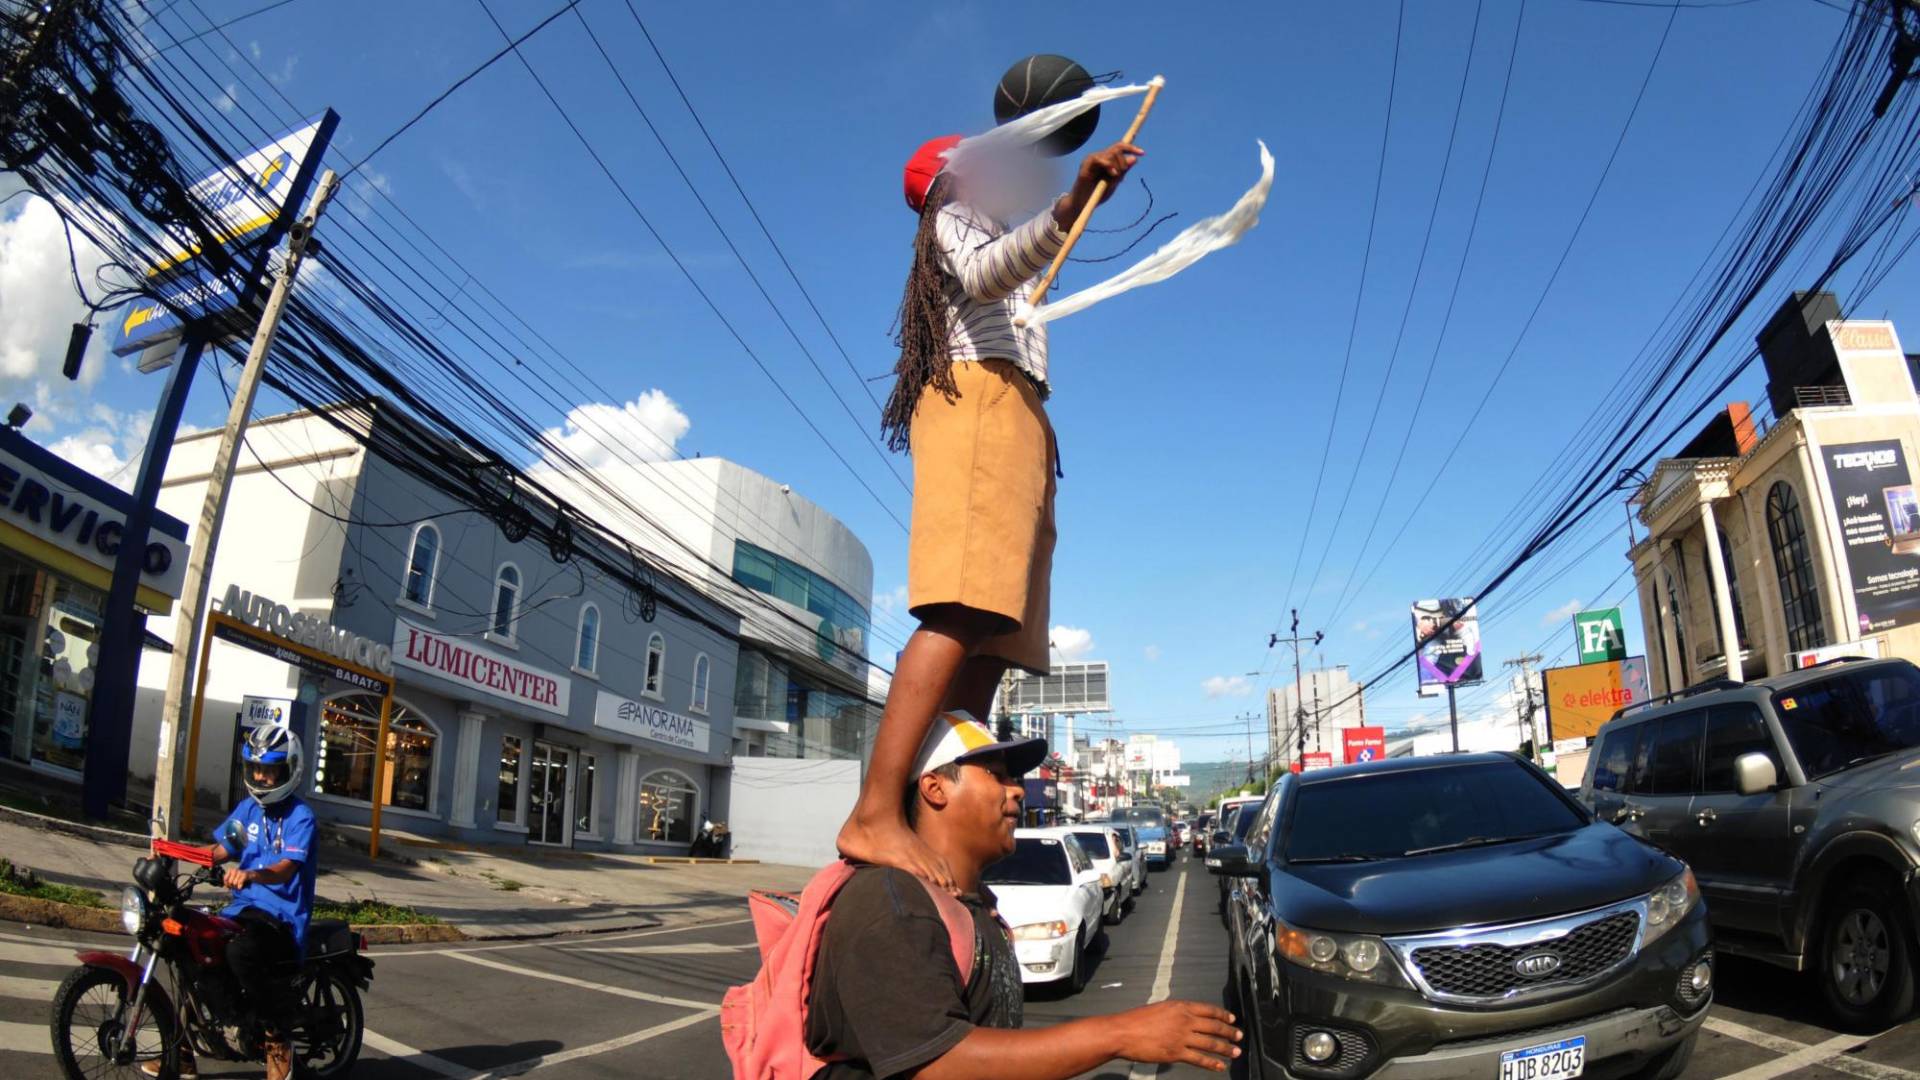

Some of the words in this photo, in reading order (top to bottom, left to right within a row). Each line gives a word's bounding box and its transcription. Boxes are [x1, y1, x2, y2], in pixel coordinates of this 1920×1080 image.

[222, 584, 392, 675] AUTOSERVICIO
[1579, 618, 1622, 654] FA
[405, 629, 559, 707] LUMICENTER
[1580, 687, 1633, 708] elektra
[627, 702, 695, 737] PANORAMA
[1524, 956, 1552, 973] KIA
[1525, 1043, 1562, 1056] HONDURAS
[1540, 1047, 1582, 1077] 8203
